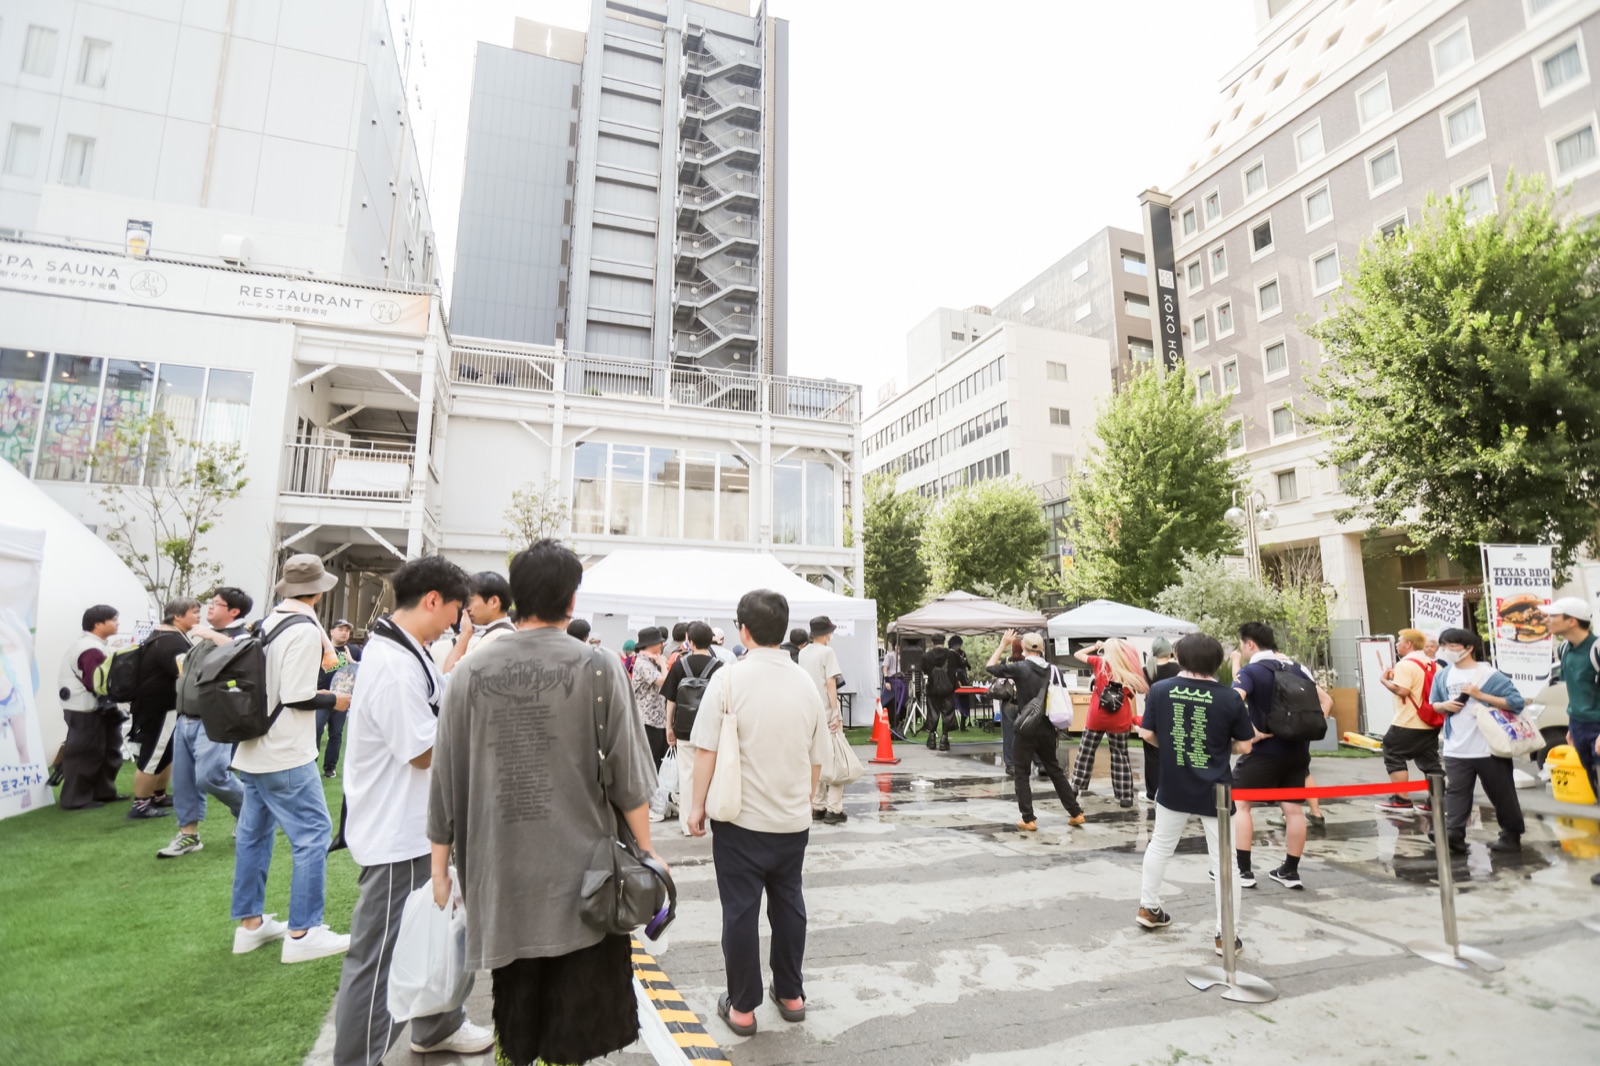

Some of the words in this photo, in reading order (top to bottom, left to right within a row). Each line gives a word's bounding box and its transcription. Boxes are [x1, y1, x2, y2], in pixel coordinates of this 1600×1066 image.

[46, 260, 120, 279] SAUNA
[239, 285, 363, 309] RESTAURANT
[237, 301, 328, 317] パーティ・二次会利用可
[1164, 294, 1175, 334] KOKO
[1493, 567, 1526, 577] TEXAS
[1529, 568, 1550, 578] BBQ
[1494, 577, 1551, 587] BURGER
[1515, 673, 1533, 681] BBQ
